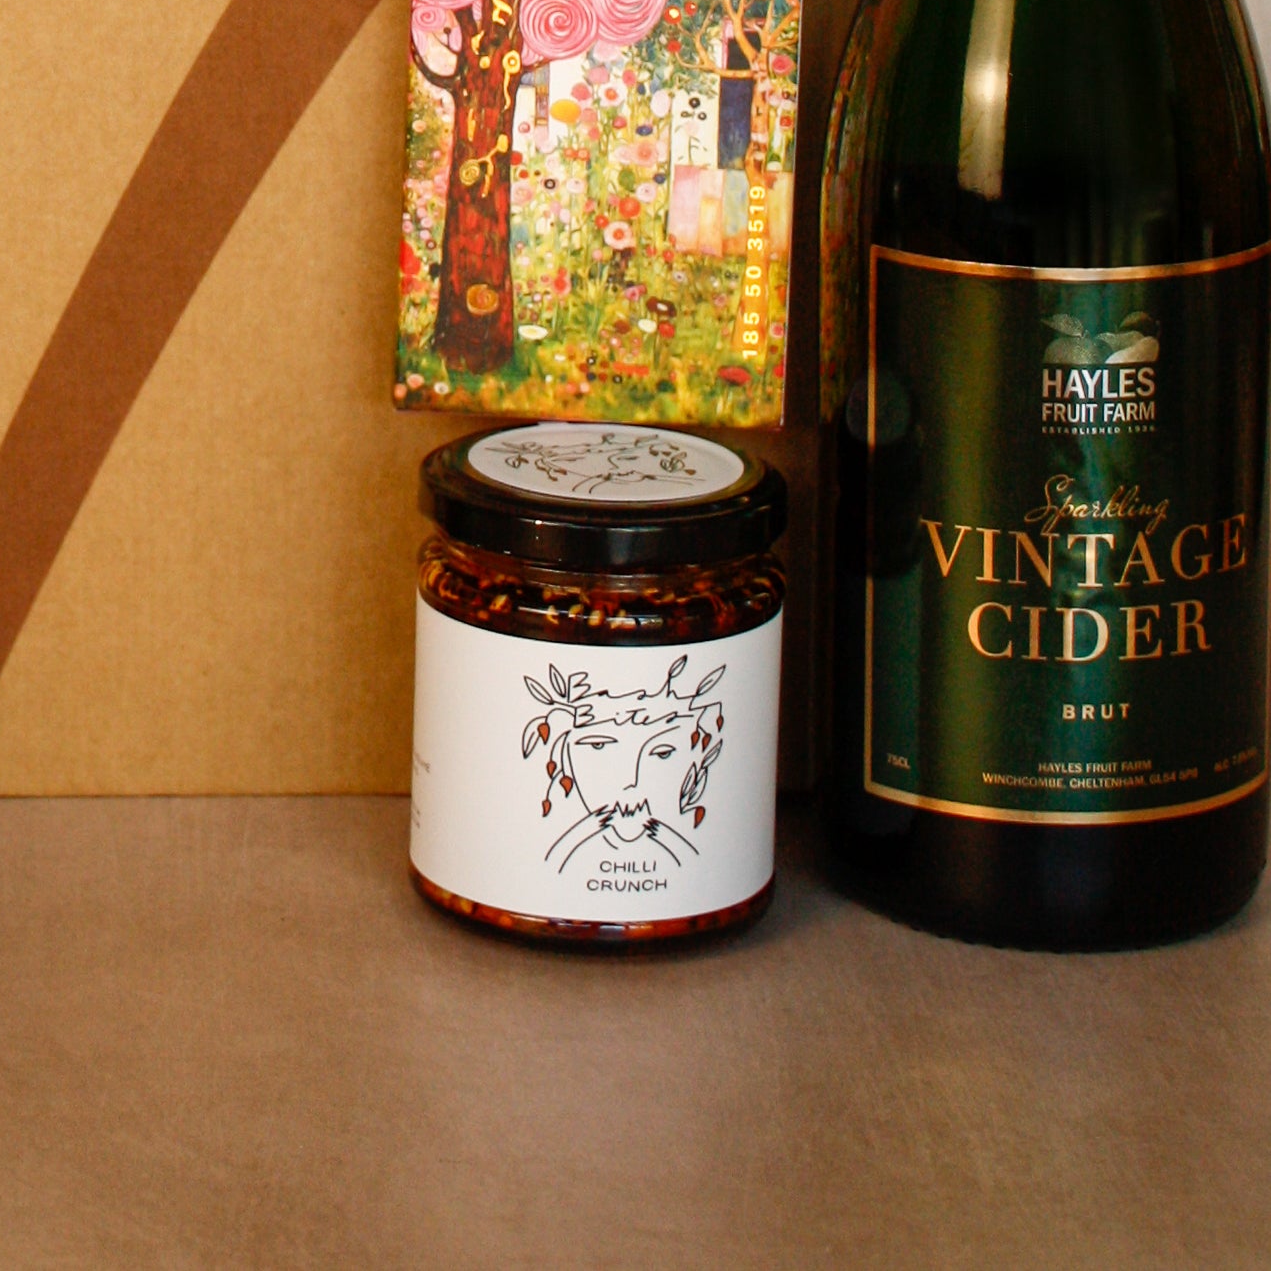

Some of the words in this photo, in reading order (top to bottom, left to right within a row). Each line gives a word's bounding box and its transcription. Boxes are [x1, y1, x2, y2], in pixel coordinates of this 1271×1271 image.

[747, 185, 766, 251] 3519
[744, 264, 762, 298] 50
[742, 311, 760, 360] 185
[1042, 367, 1156, 399] HAYLES
[1042, 402, 1098, 423] FRUIT
[1103, 401, 1155, 422] FARM
[1042, 425, 1121, 435] ESTABLISHED
[1024, 474, 1170, 535] Sparkling
[919, 513, 1248, 588] VINTAGE
[968, 599, 1212, 662] CIDER
[567, 663, 694, 703] Bash
[573, 704, 686, 728] Bites
[1062, 702, 1132, 720] BRUT
[1037, 761, 1083, 774] HAYLES
[1086, 761, 1119, 774] FRUIT
[1121, 759, 1153, 772] FARM
[599, 859, 657, 874] CHILLI
[586, 878, 668, 893] CRUNCH
